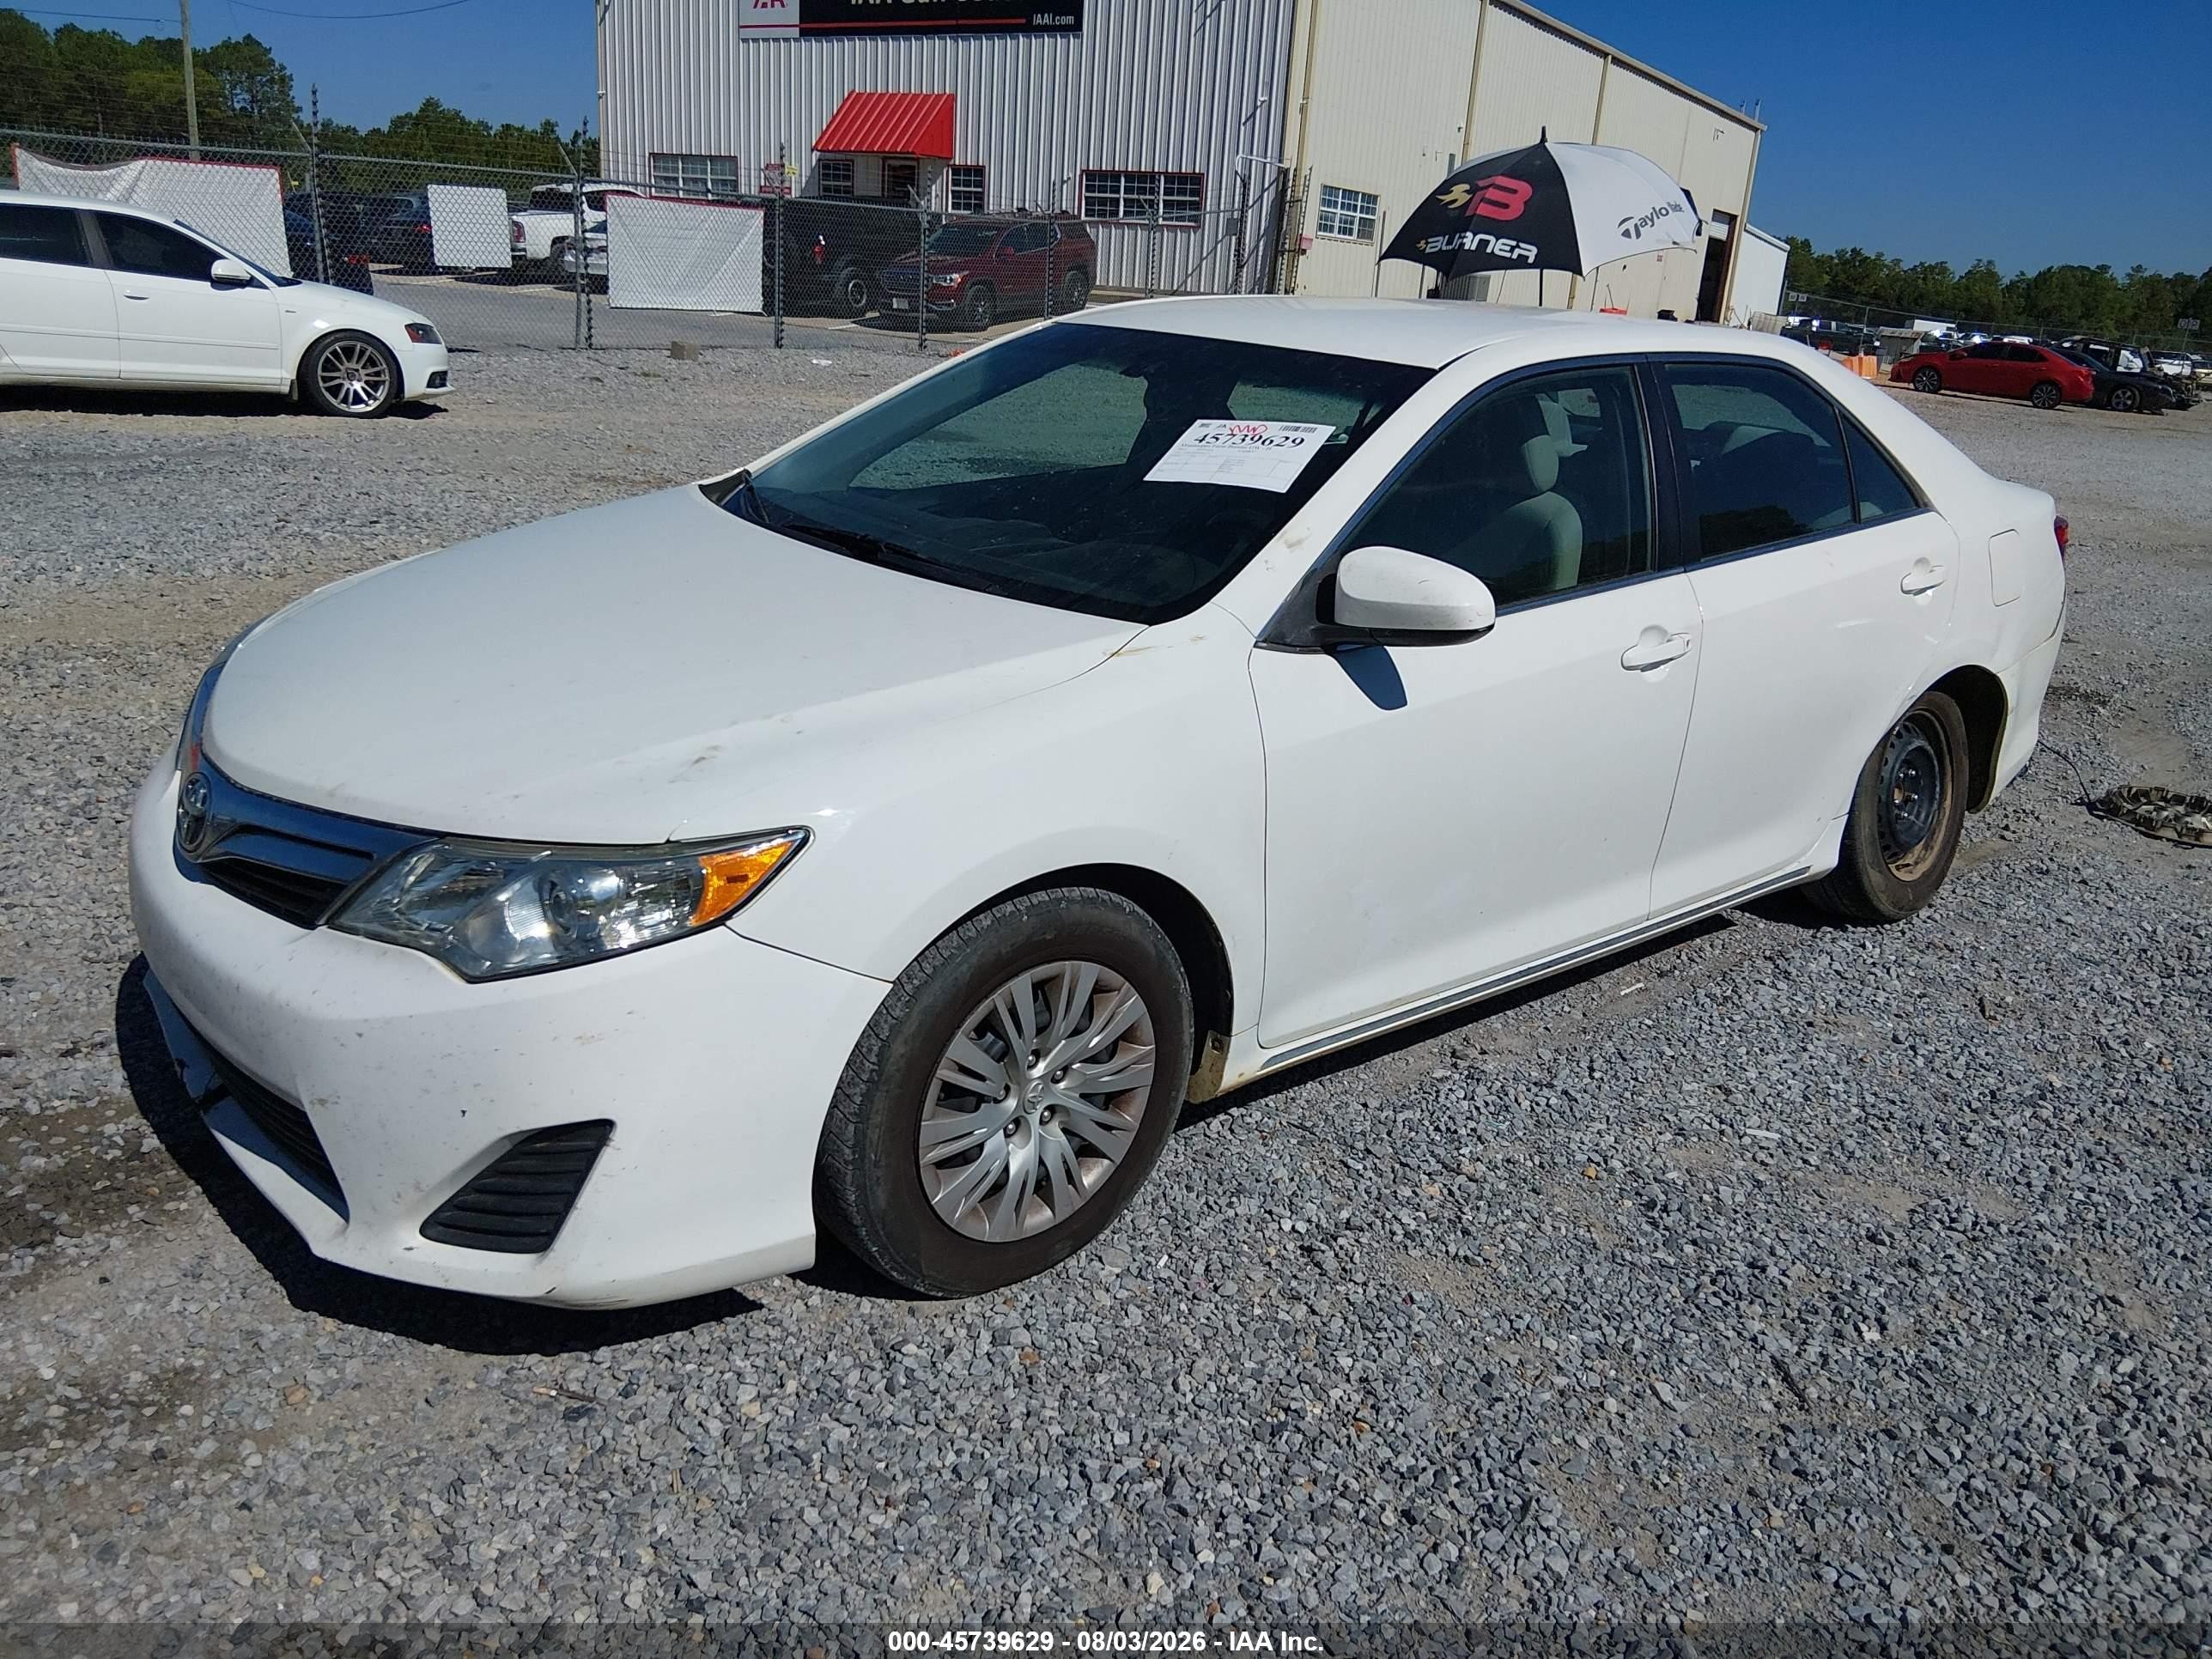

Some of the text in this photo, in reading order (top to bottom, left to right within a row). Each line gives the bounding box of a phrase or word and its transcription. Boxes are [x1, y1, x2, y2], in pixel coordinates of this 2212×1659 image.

[1033, 13, 1074, 26] IAAI.com
[1617, 201, 1683, 240] Taylo
[1425, 231, 1539, 264] BURNER
[1193, 432, 1306, 449] 45739629
